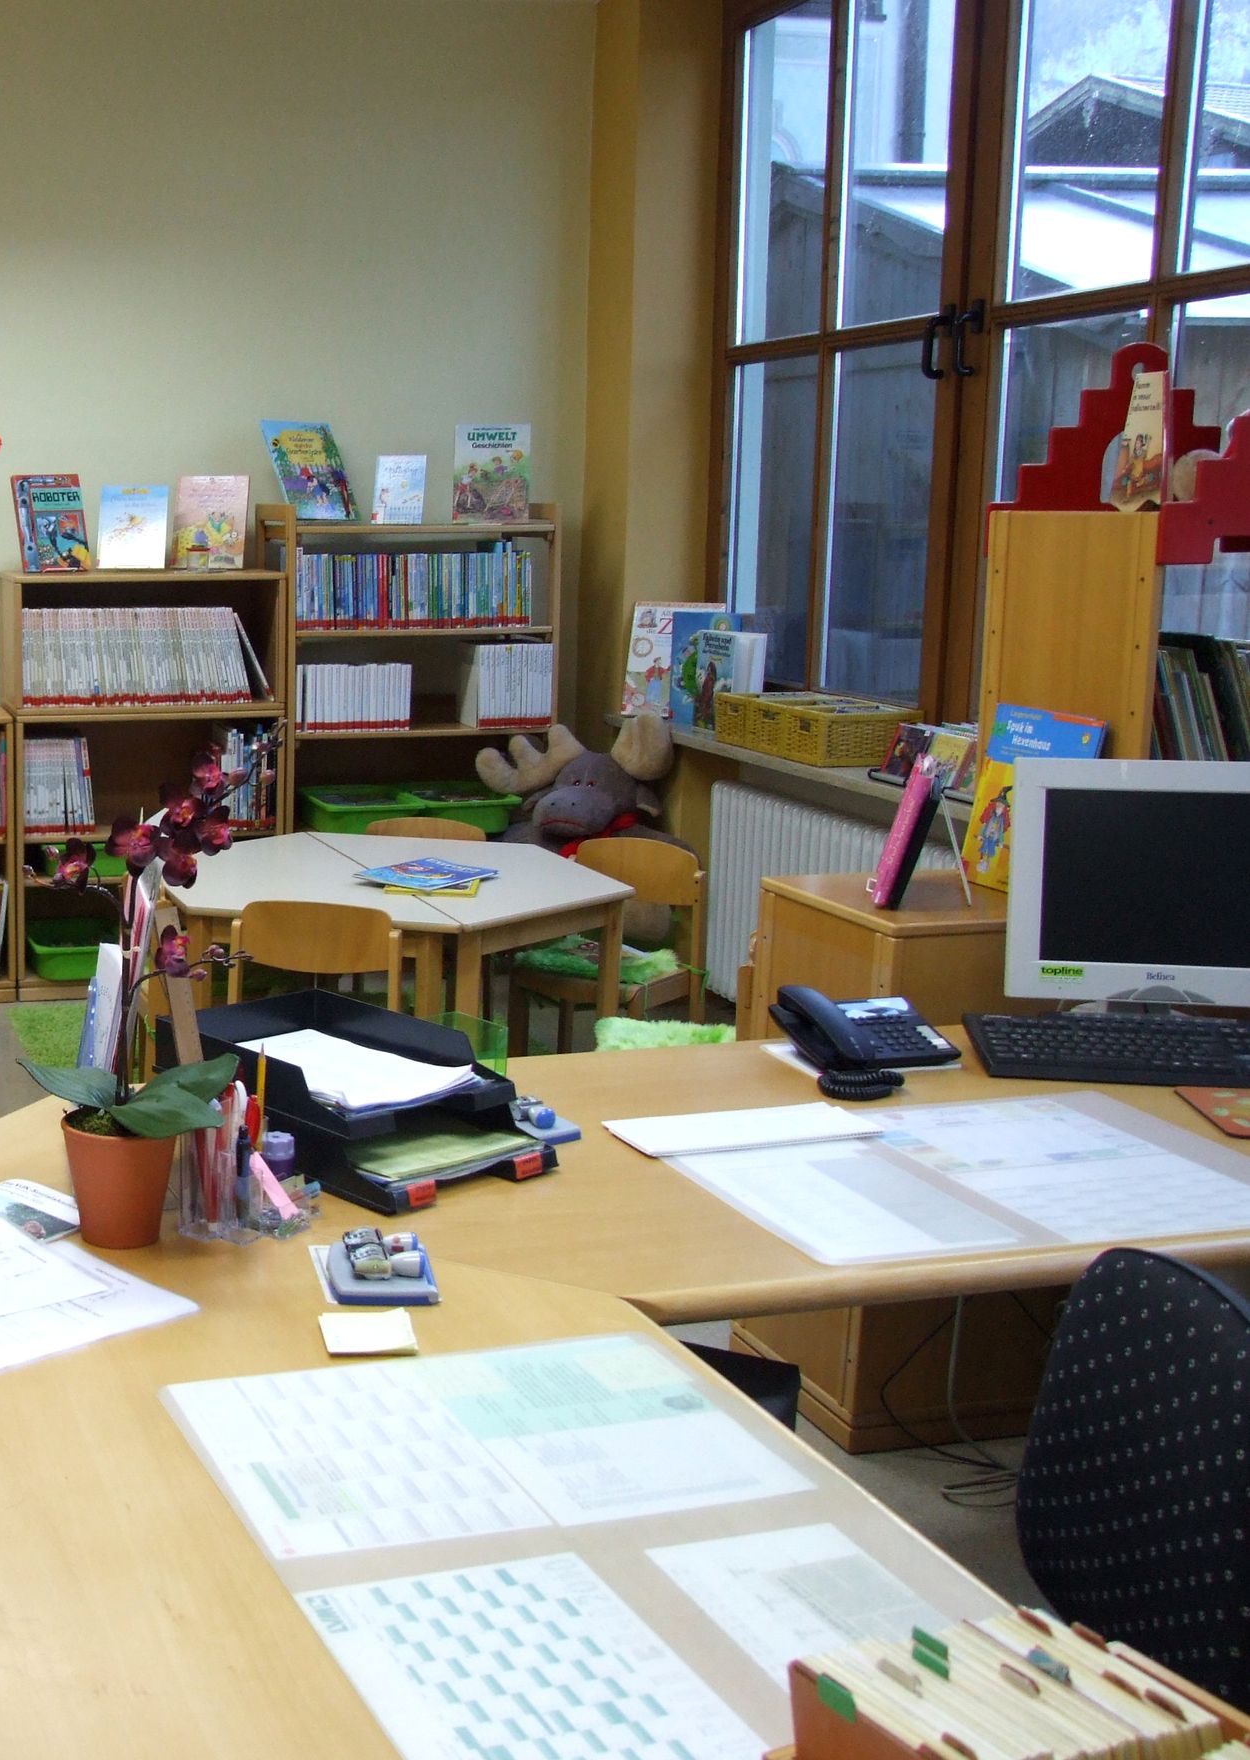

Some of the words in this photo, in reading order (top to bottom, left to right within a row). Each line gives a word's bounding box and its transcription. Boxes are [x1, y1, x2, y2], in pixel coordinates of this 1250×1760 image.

[467, 431, 517, 441] UMWELT
[32, 491, 81, 502] ROBOTER
[1006, 720, 1024, 734] Spuk
[1012, 735, 1052, 751] Hexenhaus
[1041, 966, 1084, 976] topline
[1146, 971, 1176, 981] Belinea
